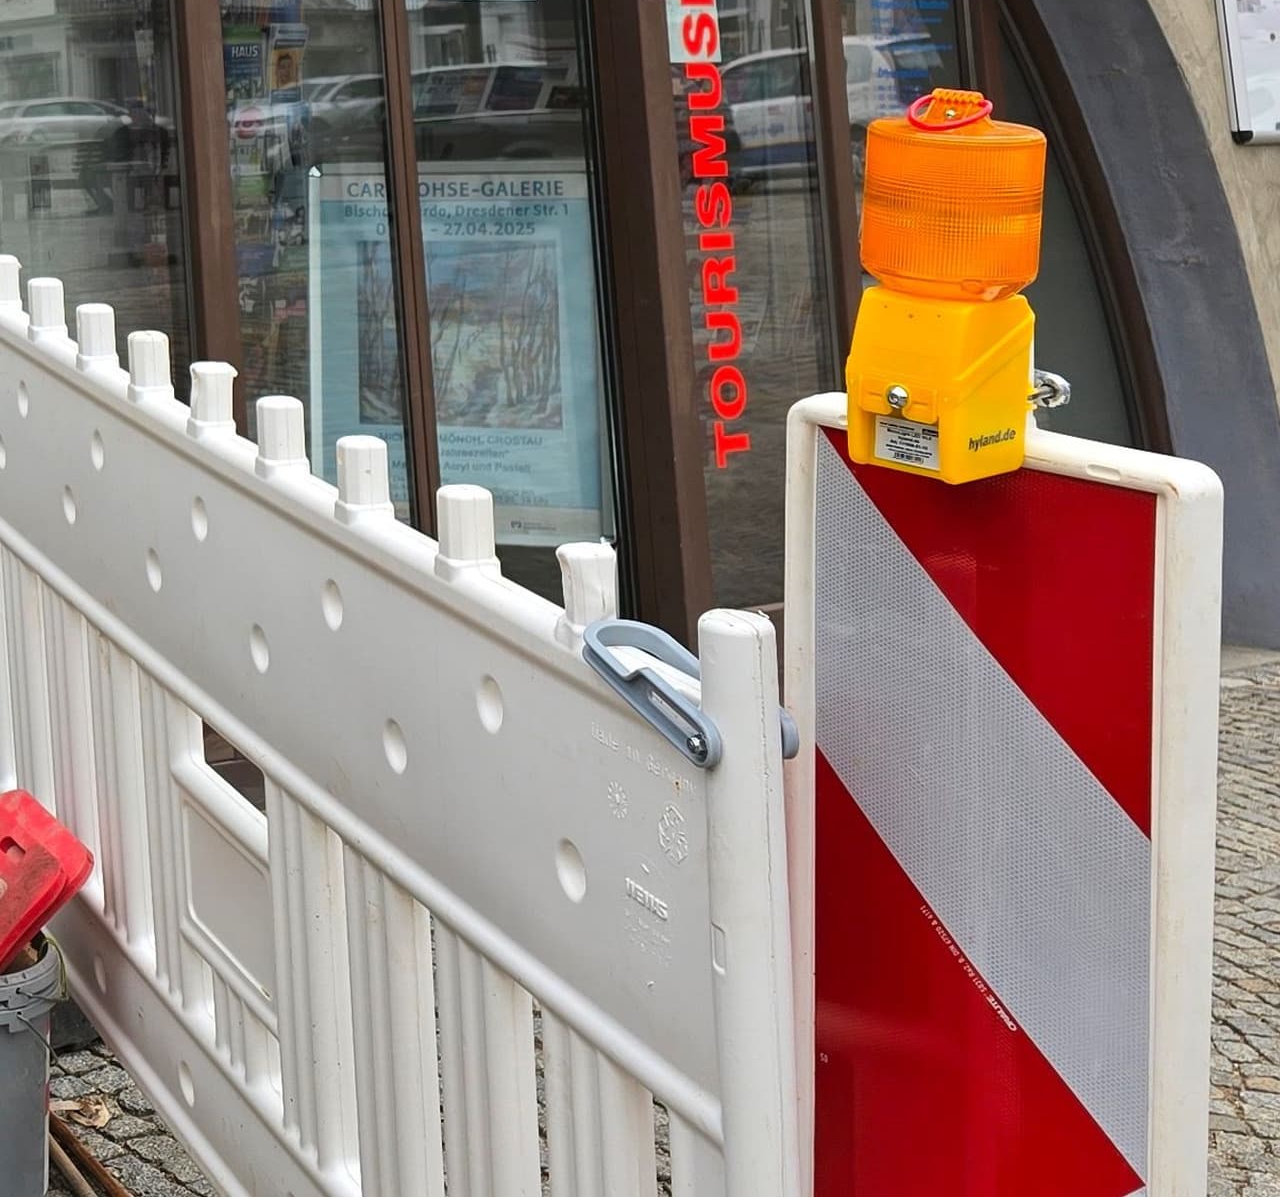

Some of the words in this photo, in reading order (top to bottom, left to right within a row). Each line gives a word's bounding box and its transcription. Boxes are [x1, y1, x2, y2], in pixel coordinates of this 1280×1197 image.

[347, 182, 386, 197] CAR
[418, 180, 564, 197] OHSE-GALERIE
[455, 203, 529, 217] Dresdener
[533, 203, 557, 216] Str.
[444, 222, 535, 236] 27.04.2025
[968, 427, 1016, 452] hyland.de
